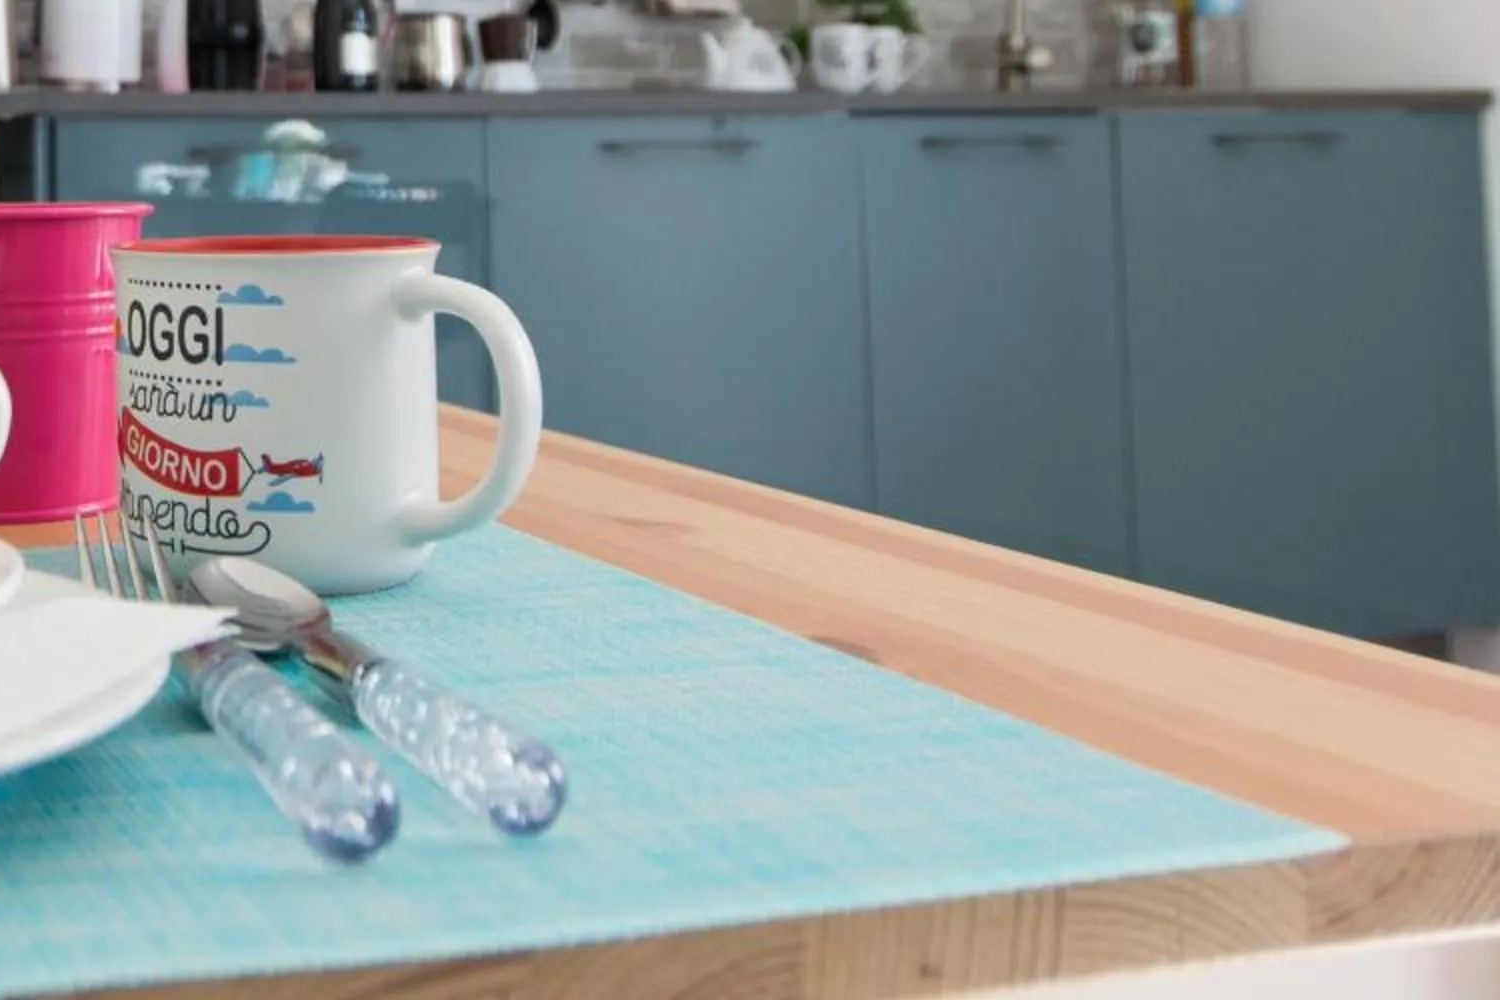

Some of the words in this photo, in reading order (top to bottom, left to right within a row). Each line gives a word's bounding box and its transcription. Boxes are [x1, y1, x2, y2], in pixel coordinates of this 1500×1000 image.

[127, 299, 224, 366] OGGI
[188, 391, 237, 423] un
[126, 424, 228, 491] GIORNO
